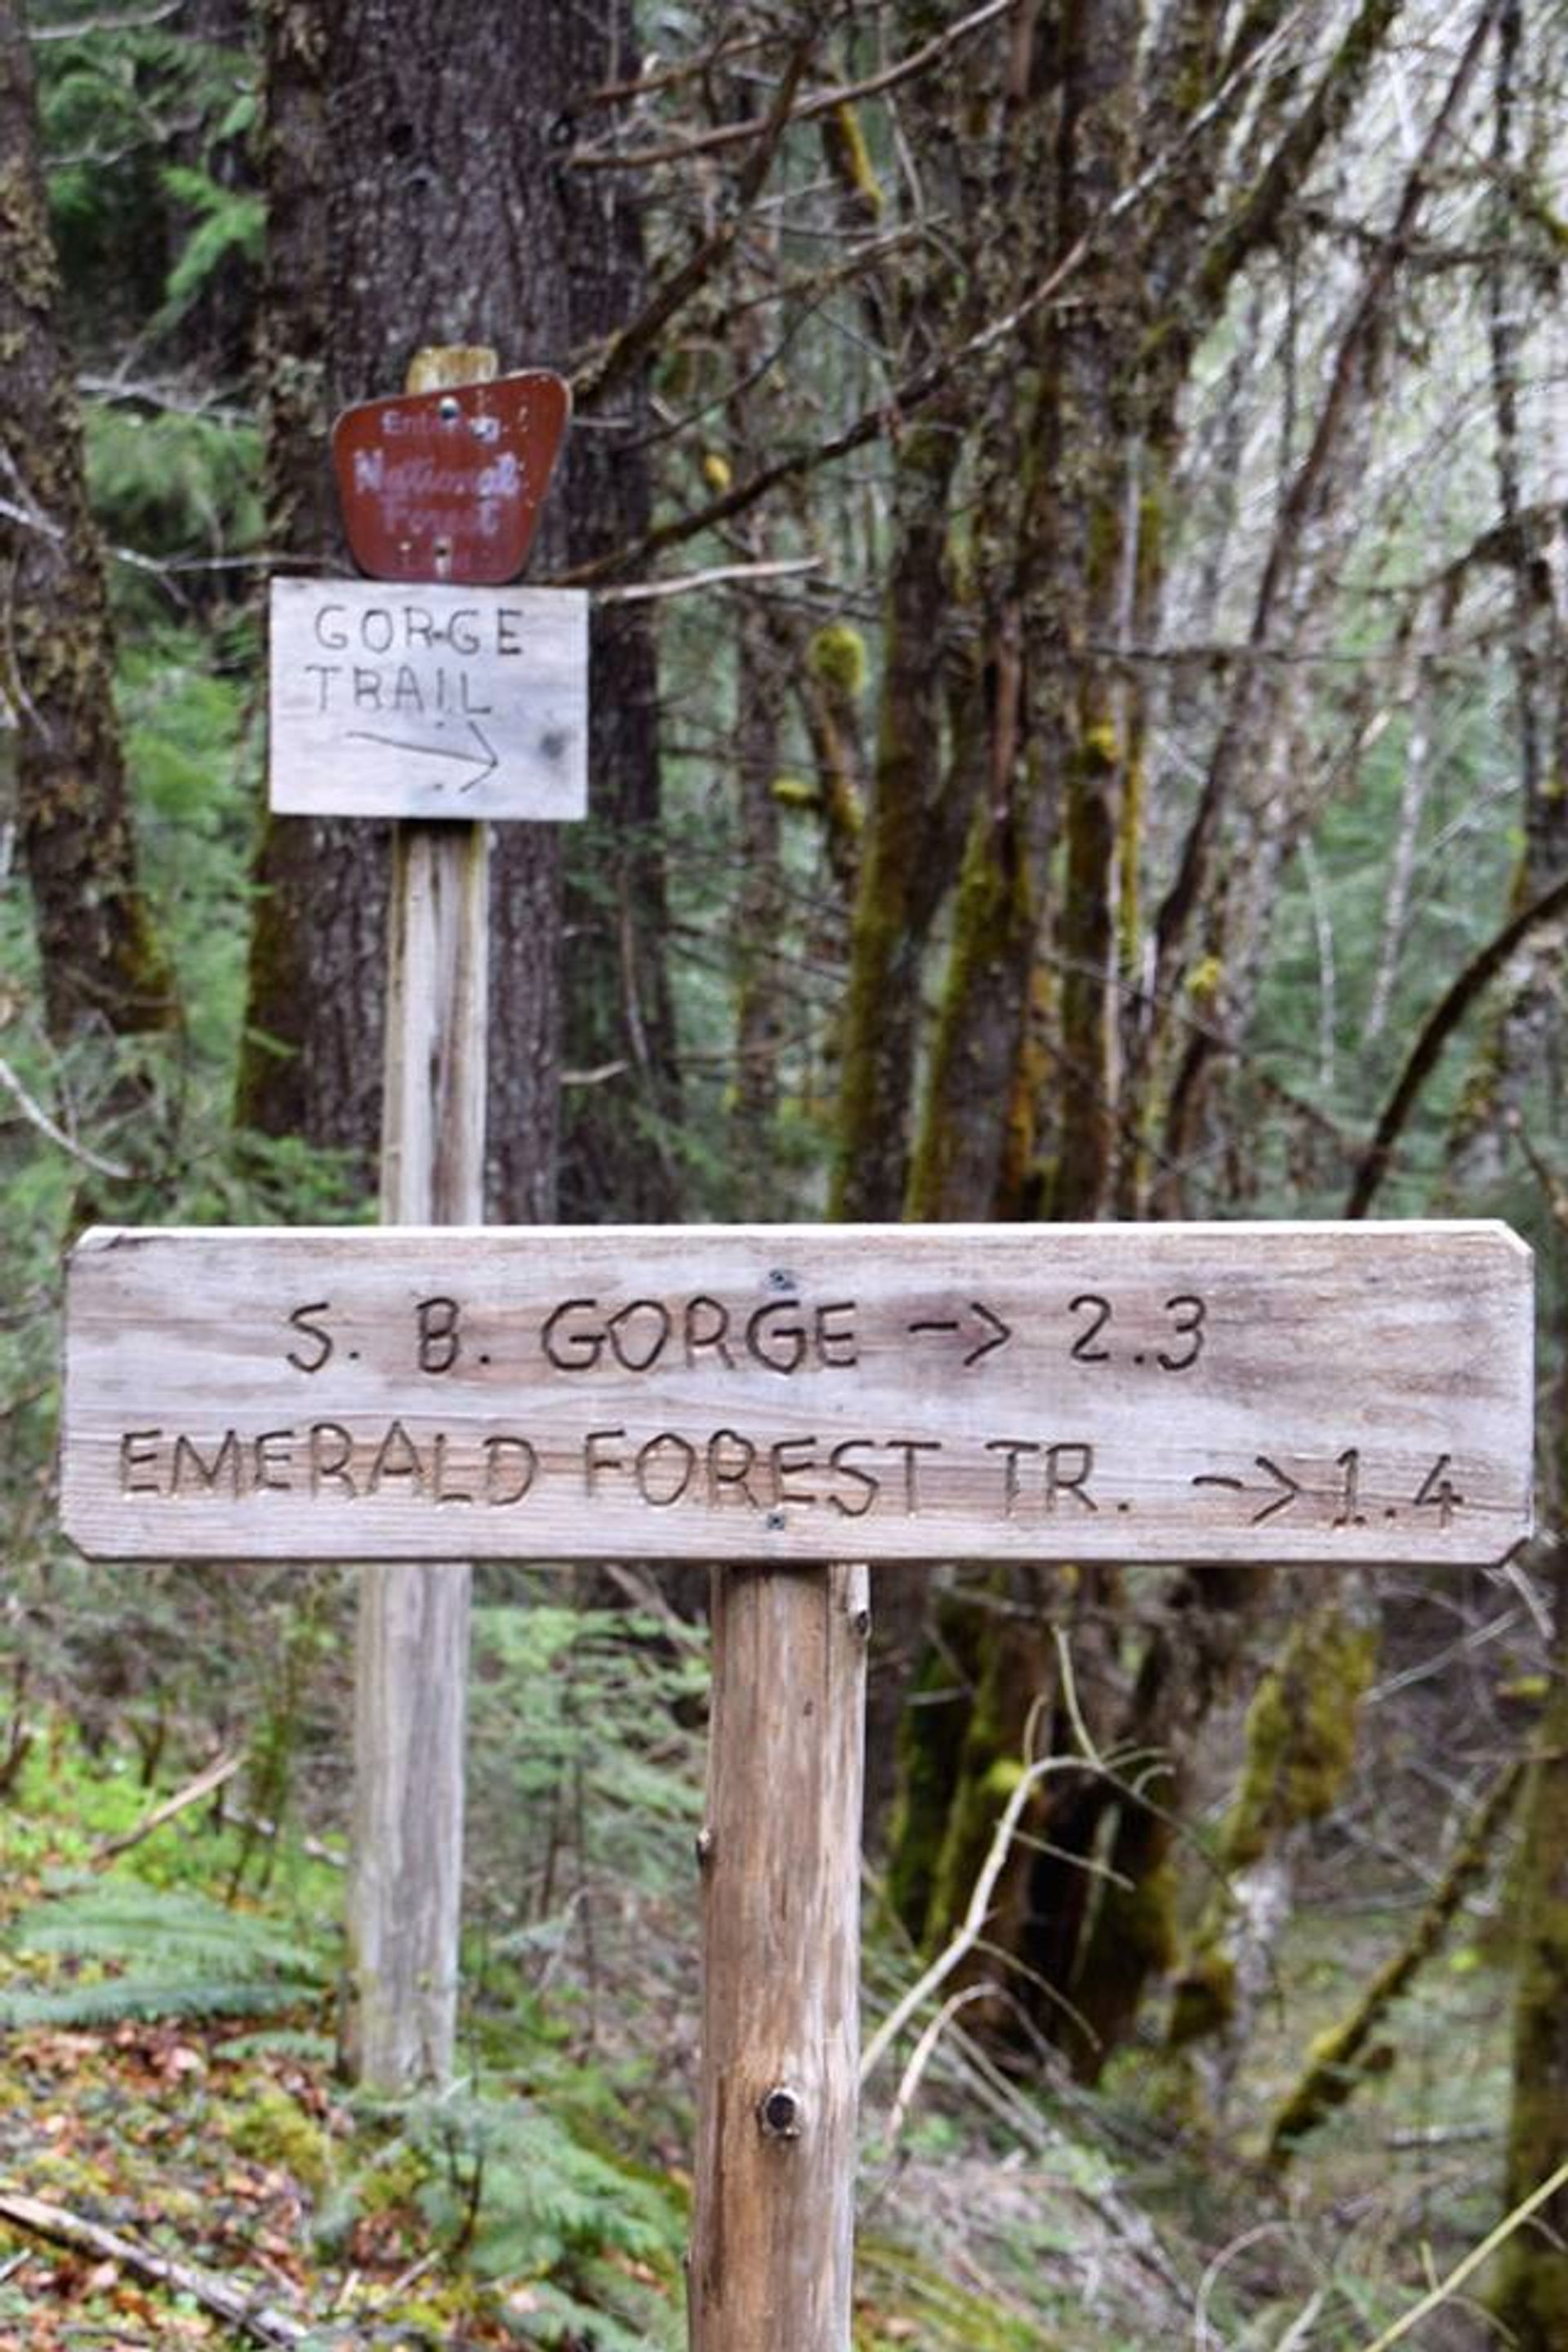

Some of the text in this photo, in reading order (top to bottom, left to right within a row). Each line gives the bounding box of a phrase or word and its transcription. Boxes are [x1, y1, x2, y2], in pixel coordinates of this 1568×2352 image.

[314, 604, 524, 655] GORGE
[304, 664, 492, 715] TRAIL
[285, 1294, 1207, 1375] S. B. GORGE 2.3
[119, 1420, 1464, 1528] EMERALD FOREST TR. 1.4
